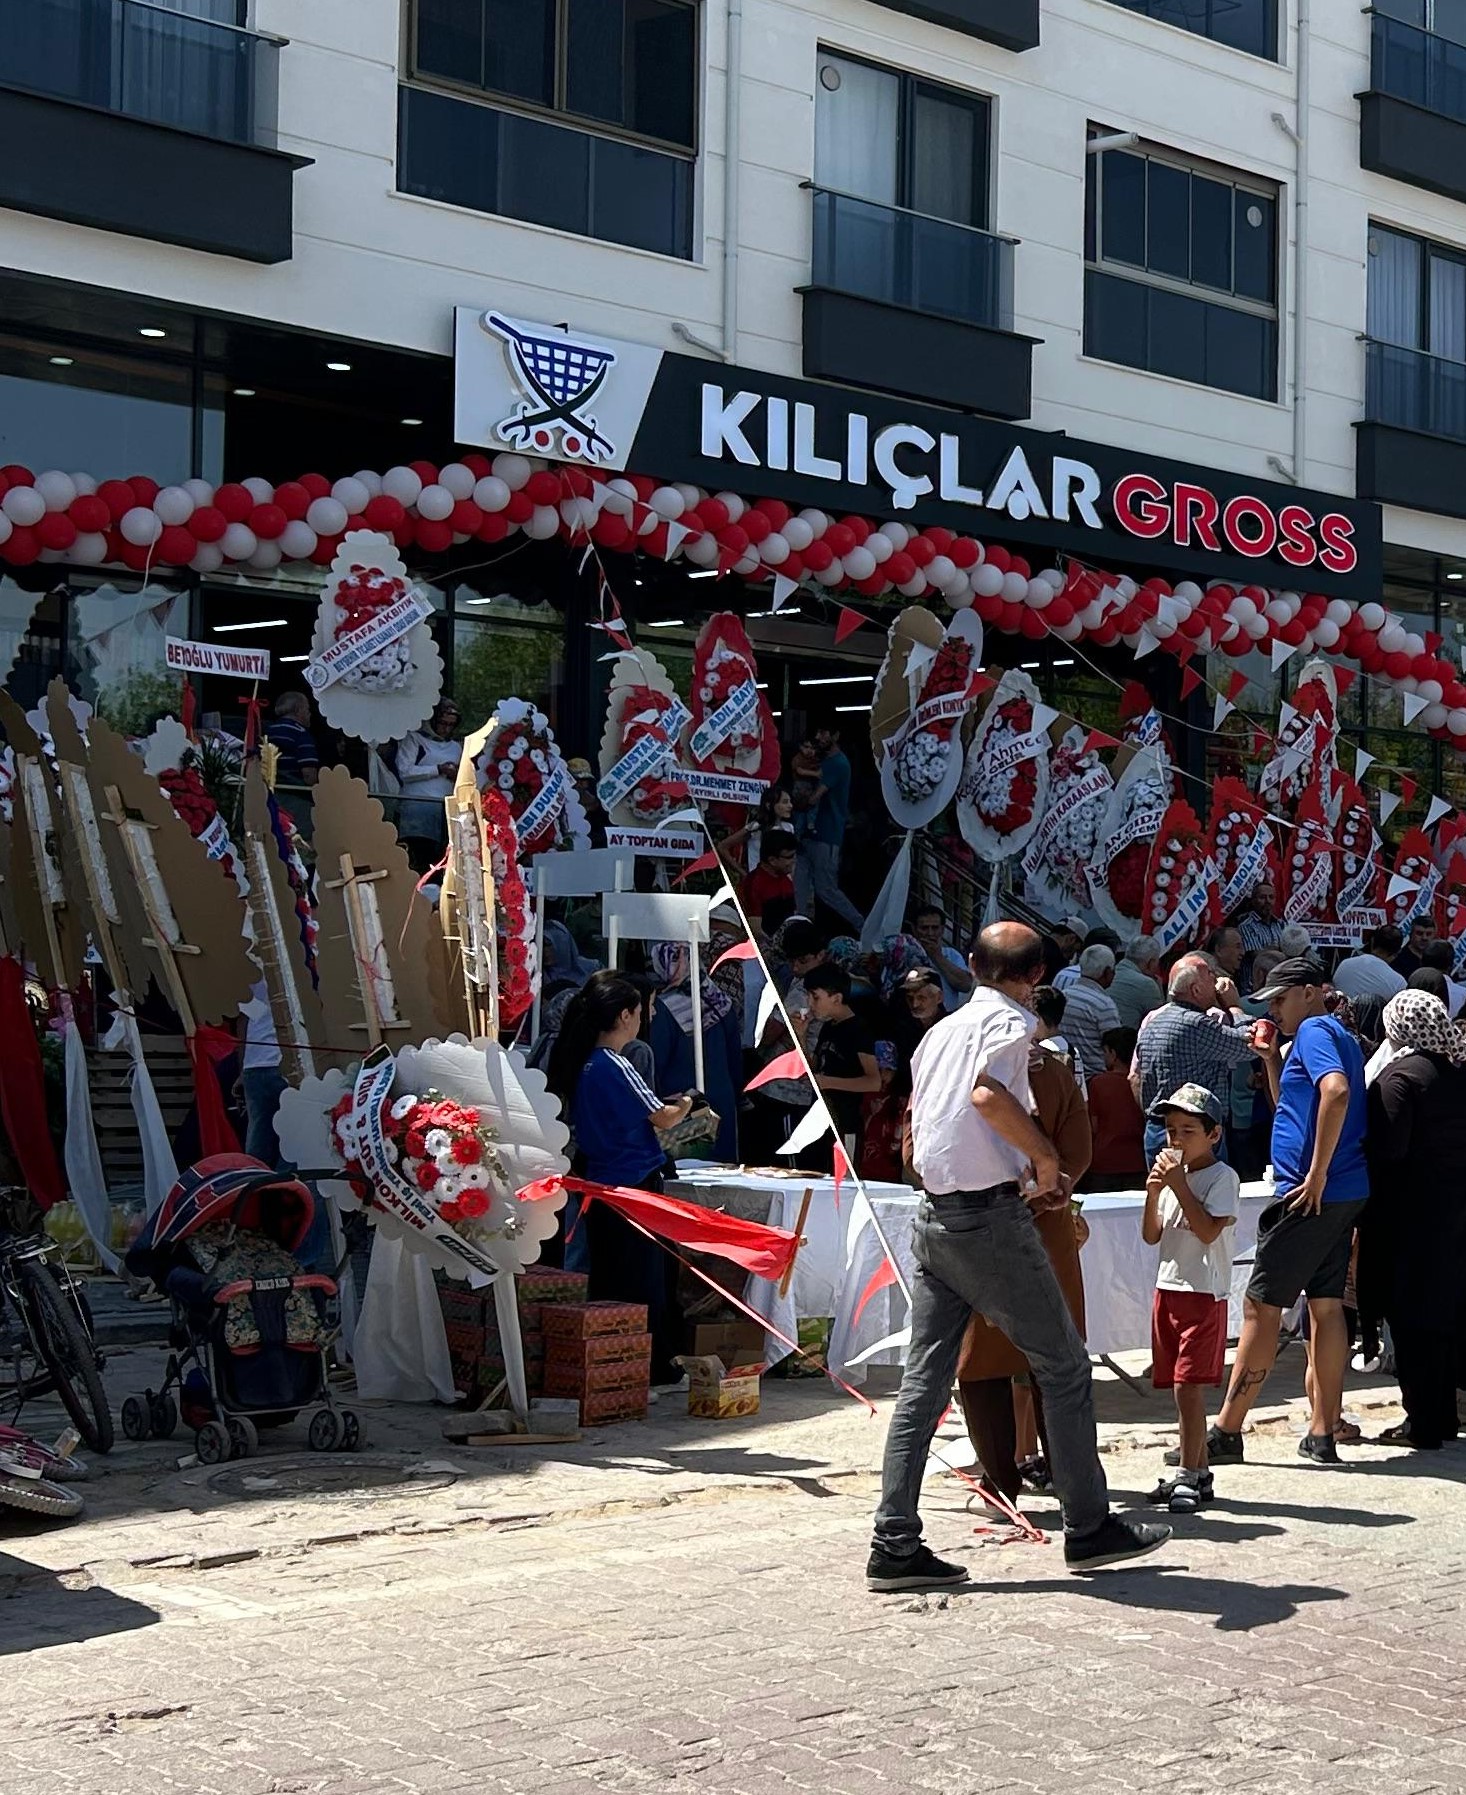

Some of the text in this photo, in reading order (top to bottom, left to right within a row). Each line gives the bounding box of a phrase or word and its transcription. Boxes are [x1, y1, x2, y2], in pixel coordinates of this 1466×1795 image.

[701, 383, 1358, 573] KILIÇLAR GROSS
[322, 624, 376, 664] MUSTAFA
[377, 596, 415, 629] AKBIYIK
[611, 734, 656, 780] MUSTAF
[1056, 773, 1109, 820] KARAASLAN
[609, 833, 696, 851] AY TOPTAN GIDA
[1230, 853, 1258, 889] MOLA
[356, 1070, 427, 1230] MİLKON SÜT & GIDA
